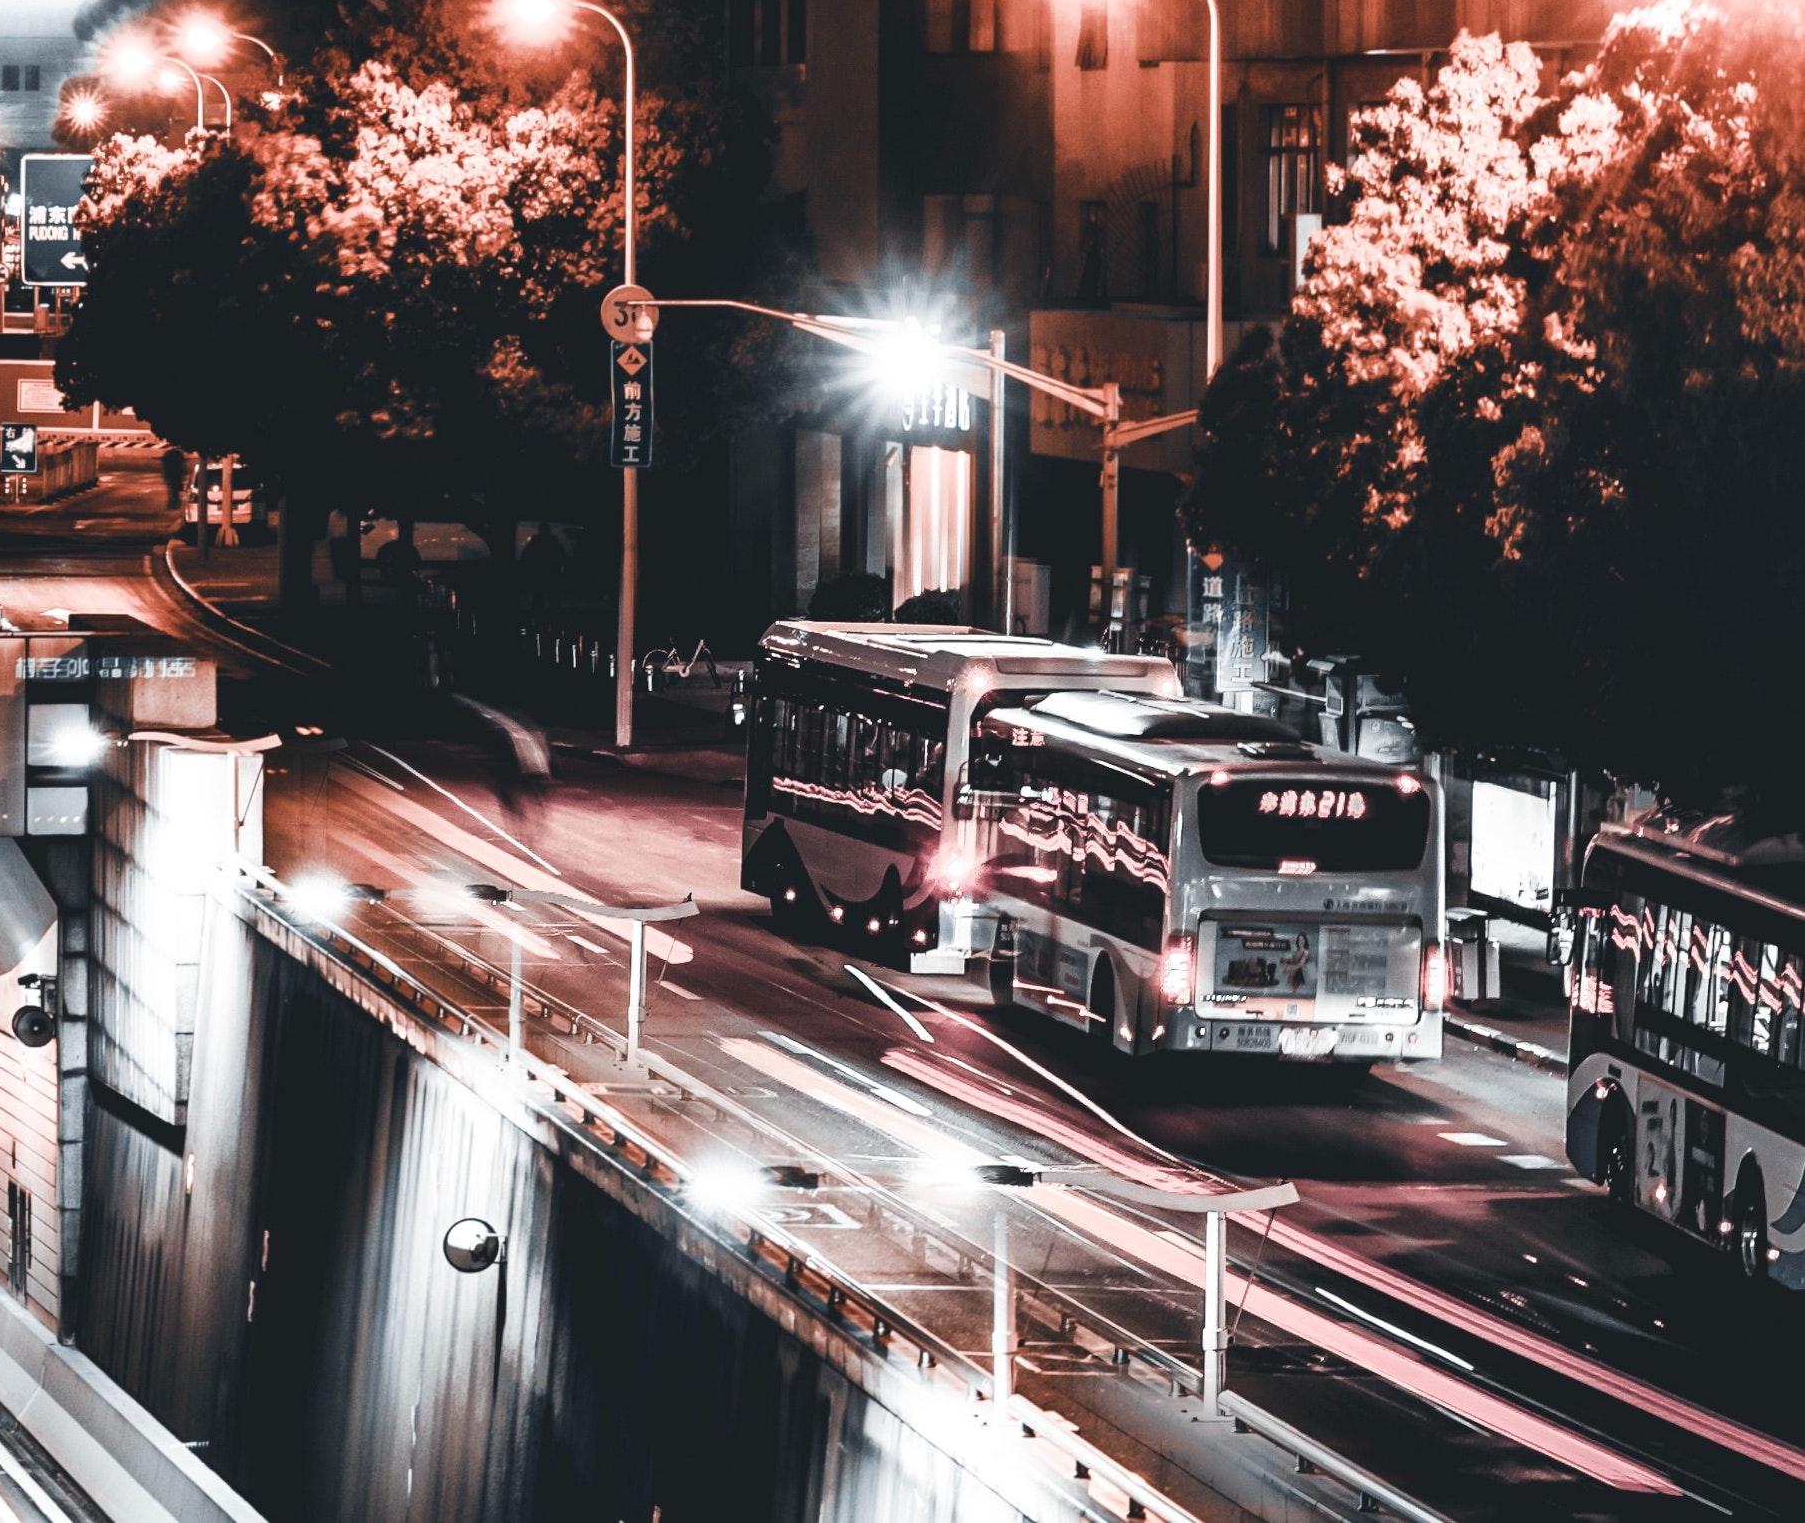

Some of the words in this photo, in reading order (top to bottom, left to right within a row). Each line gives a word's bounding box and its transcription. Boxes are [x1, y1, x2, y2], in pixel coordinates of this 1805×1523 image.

[28, 226, 69, 241] PUDONG
[622, 380, 642, 462] 前方施工
